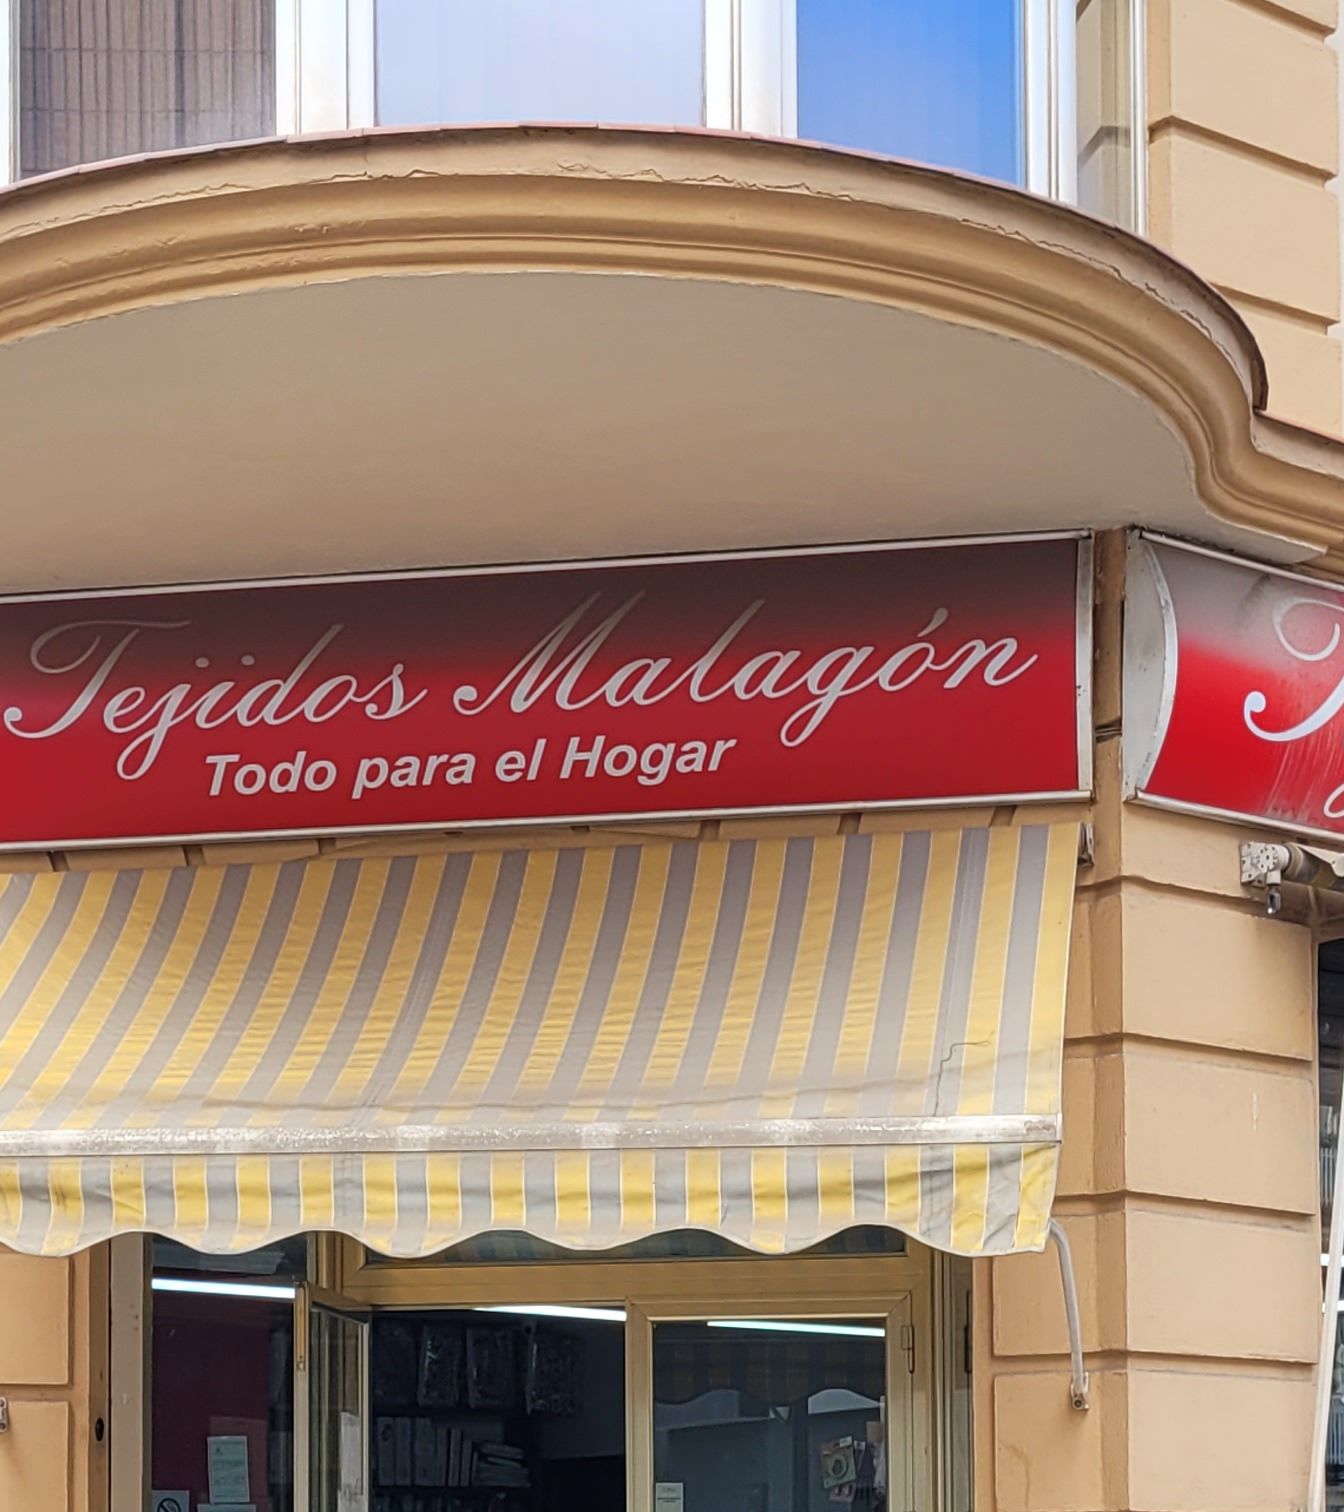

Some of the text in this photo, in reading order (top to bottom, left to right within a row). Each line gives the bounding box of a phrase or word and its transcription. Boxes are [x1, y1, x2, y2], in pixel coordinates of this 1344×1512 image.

[3, 590, 1039, 780] Tejidos Malagón
[205, 734, 738, 800] Todo para el Hogar
